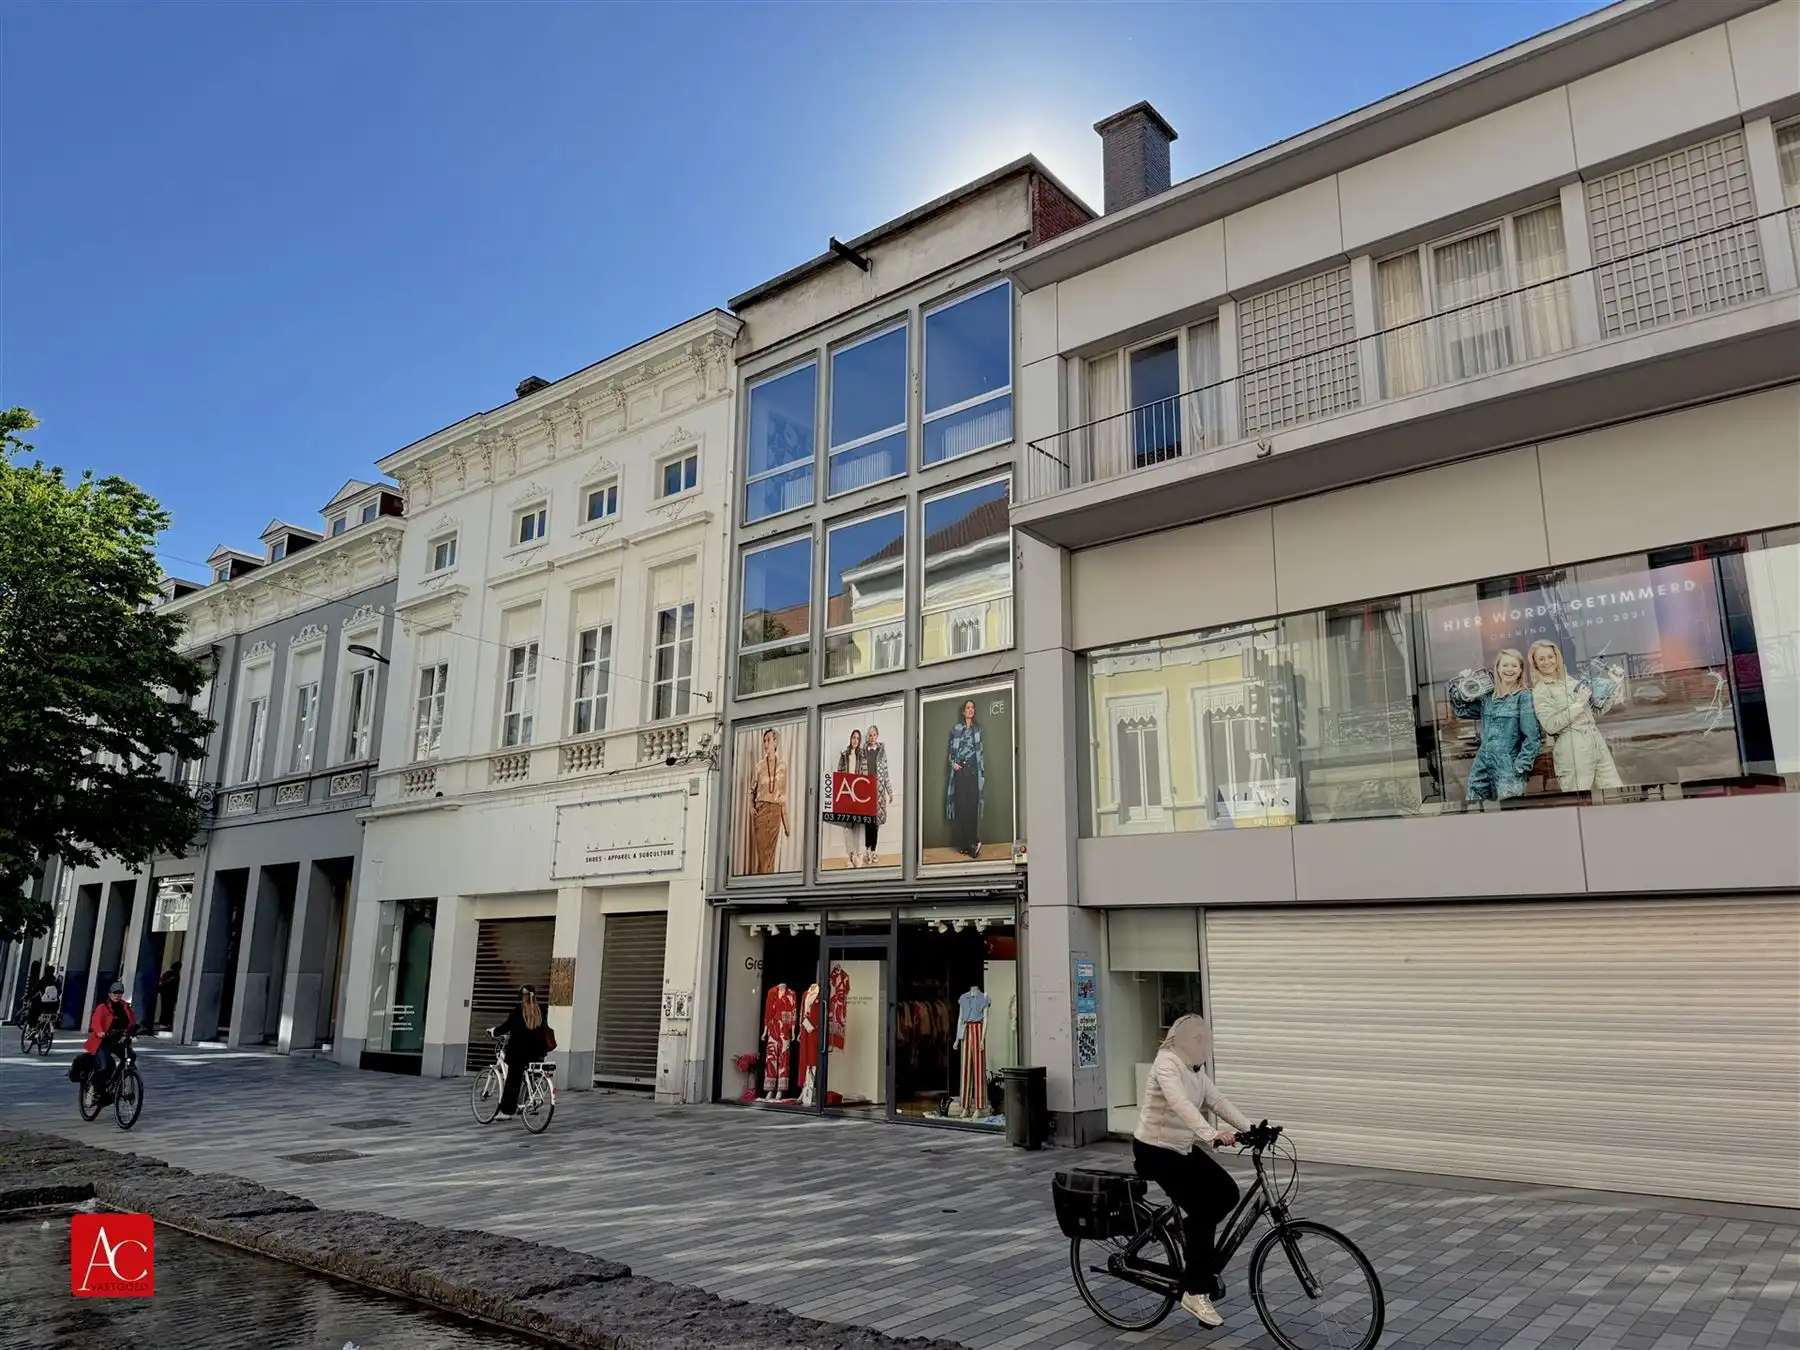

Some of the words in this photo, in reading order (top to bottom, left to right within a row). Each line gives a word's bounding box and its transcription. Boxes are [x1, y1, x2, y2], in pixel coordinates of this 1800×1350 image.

[1443, 616, 1483, 632] HIER
[1570, 579, 1696, 610] GETIMMERD
[1490, 625, 1547, 641] OPENING
[1612, 610, 1646, 622] 2021
[835, 777, 872, 803] AC
[825, 801, 832, 809] TE
[837, 814, 850, 822] 777
[852, 815, 862, 823] 93
[862, 816, 872, 824] 93
[639, 849, 674, 858] SUBCULTURE
